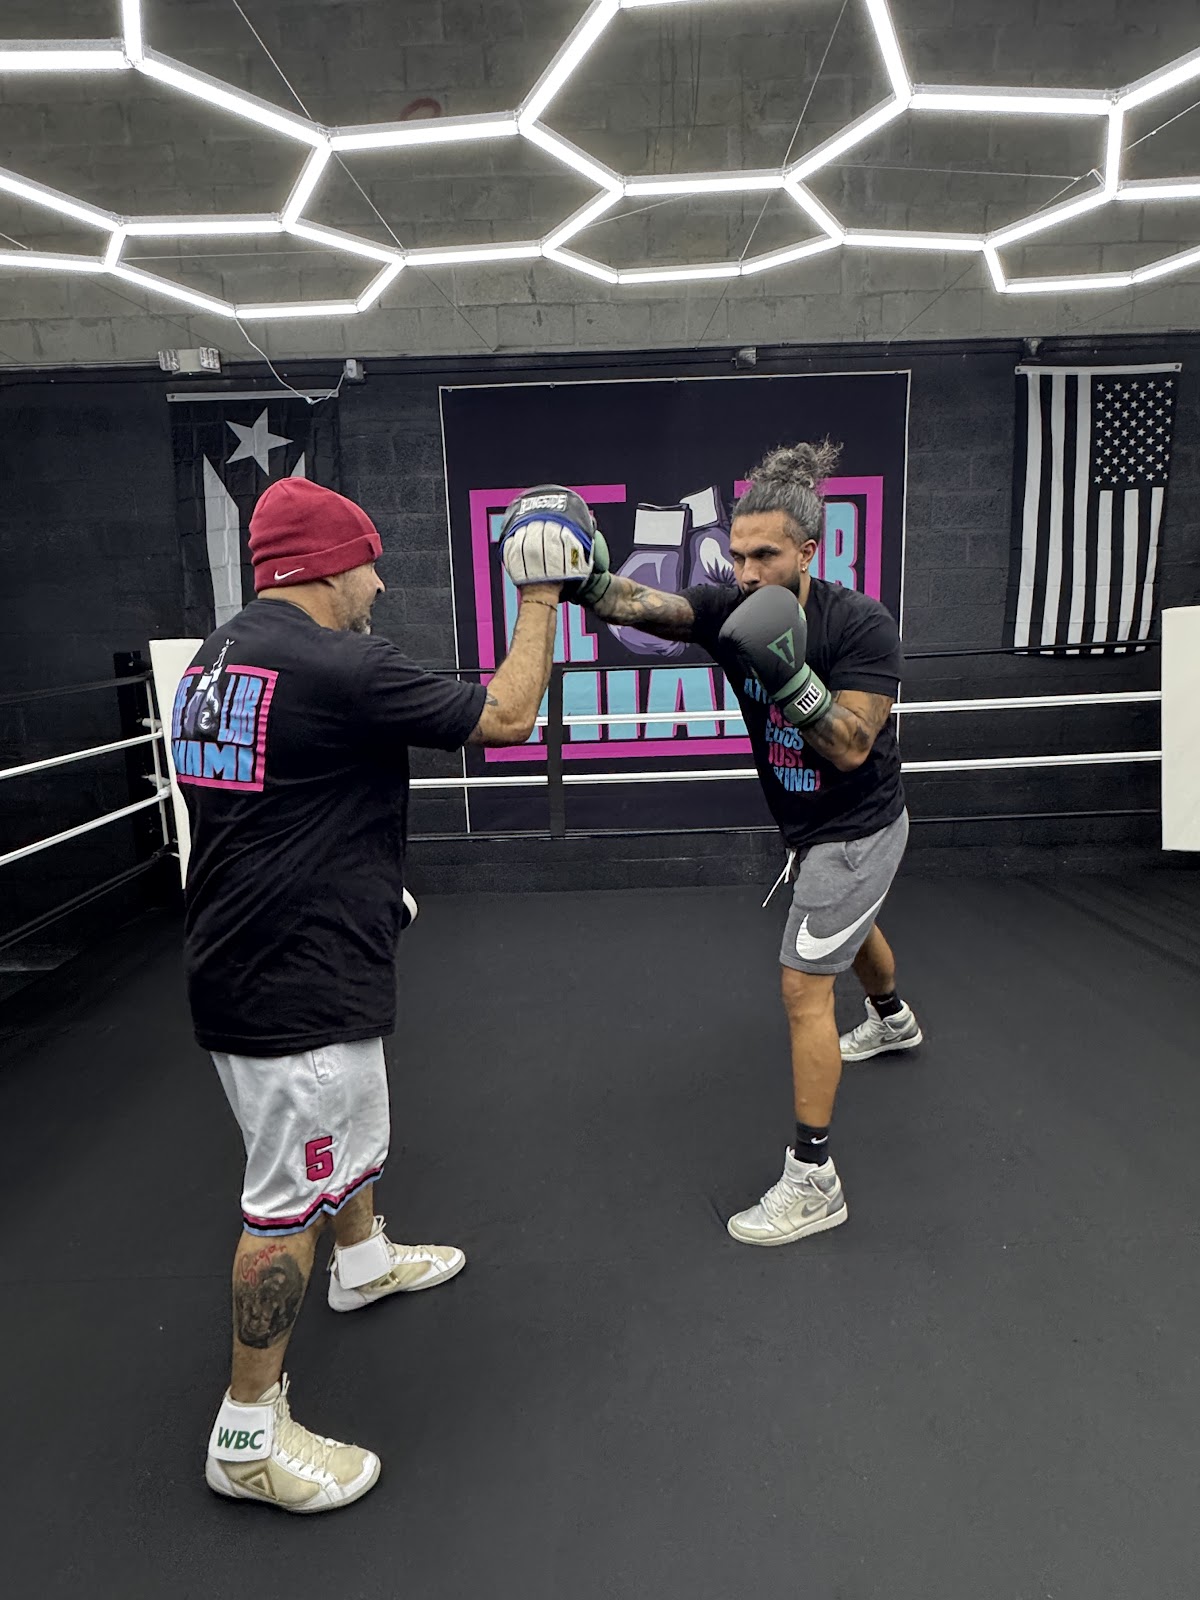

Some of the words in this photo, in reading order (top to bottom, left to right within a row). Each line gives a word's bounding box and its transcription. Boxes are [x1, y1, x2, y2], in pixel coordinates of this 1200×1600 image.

[796, 685, 821, 712] TITLE
[305, 1135, 334, 1182] 5
[217, 1426, 265, 1450] WBC
